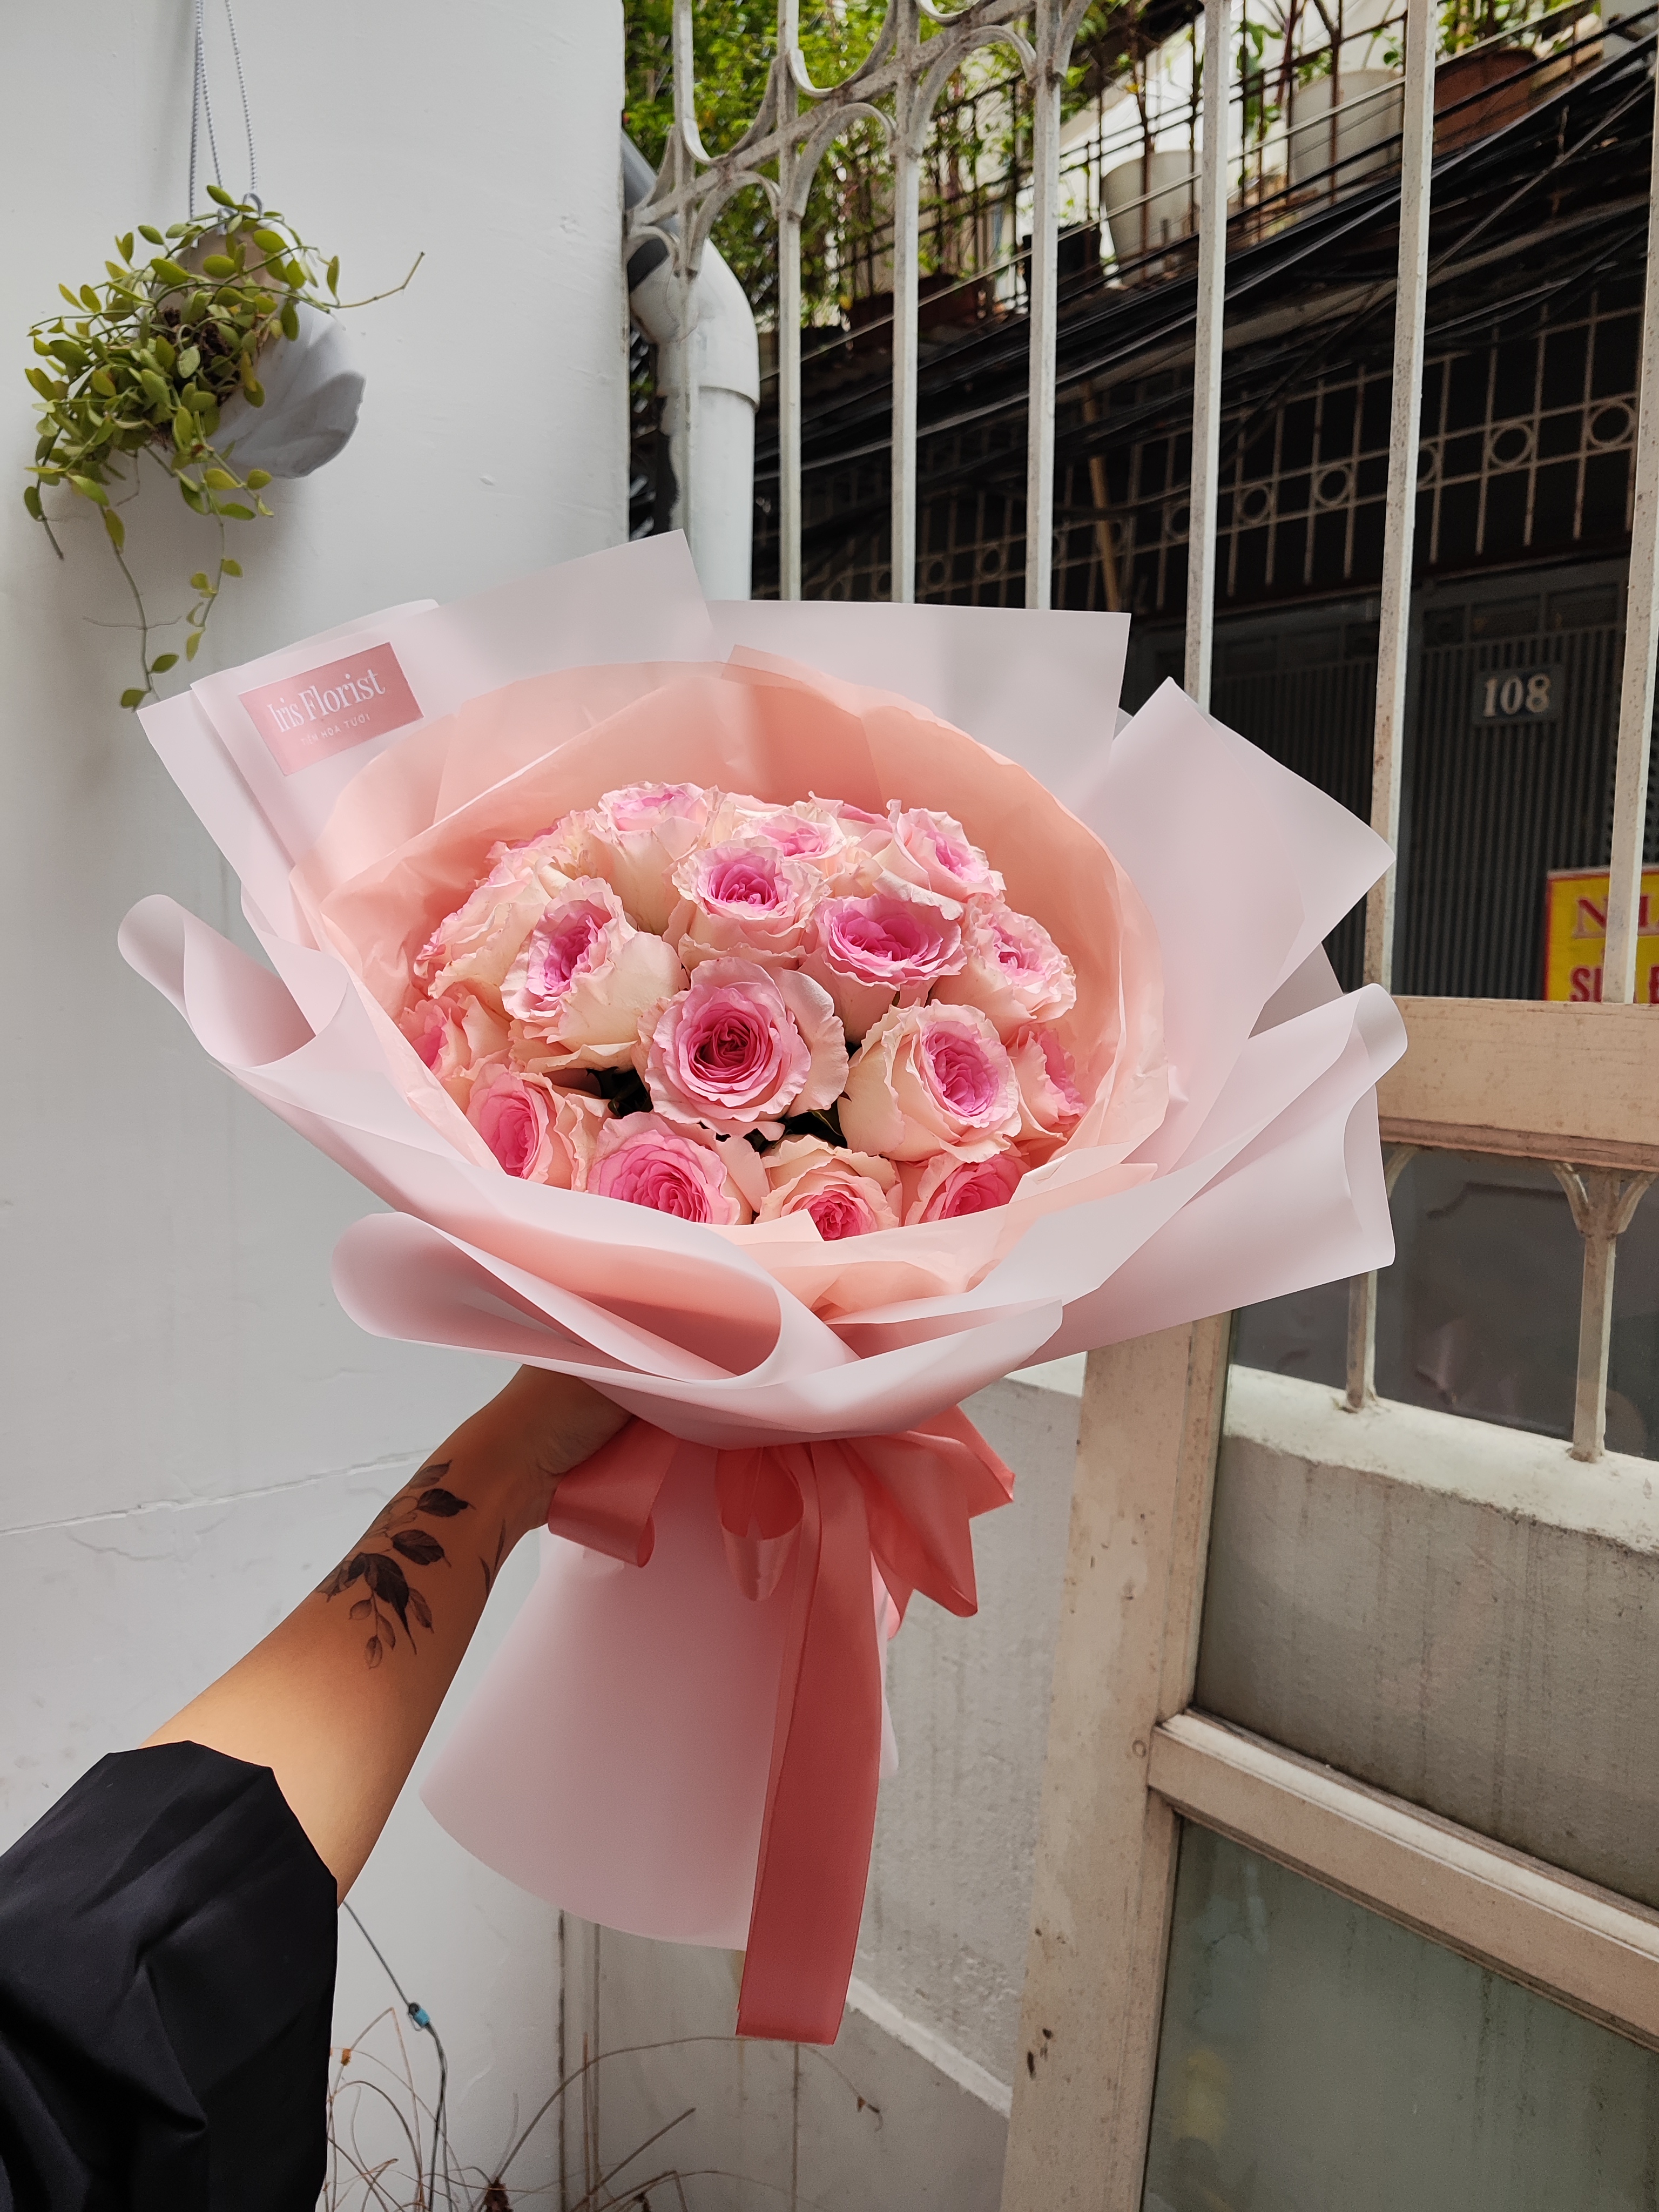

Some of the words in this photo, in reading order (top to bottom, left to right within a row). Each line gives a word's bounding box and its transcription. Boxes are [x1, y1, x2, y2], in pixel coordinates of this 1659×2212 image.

[267, 698, 304, 732] Iris
[298, 669, 386, 721] Florist
[1483, 673, 1551, 717] 108
[320, 725, 341, 739] HOA
